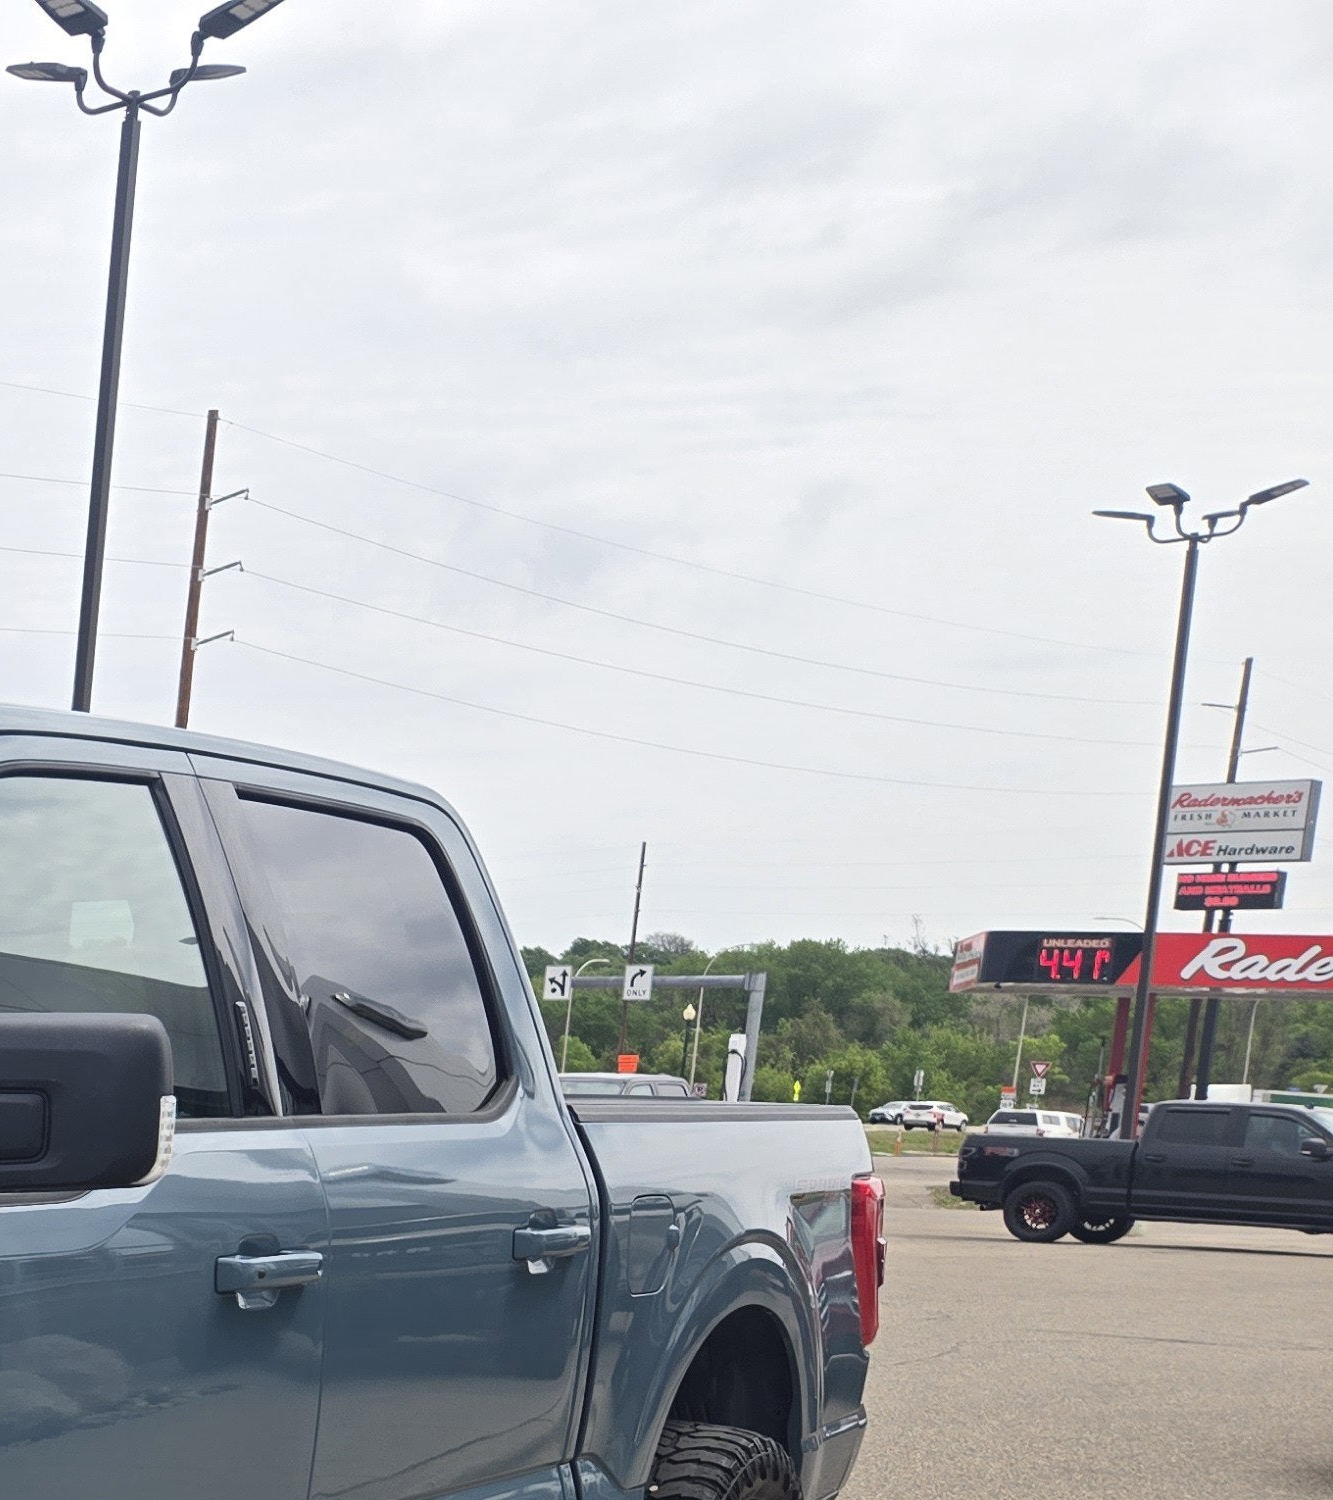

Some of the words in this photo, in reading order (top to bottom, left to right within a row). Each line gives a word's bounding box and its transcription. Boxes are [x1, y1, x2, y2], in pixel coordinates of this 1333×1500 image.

[1171, 790, 1304, 809] Radermacher's
[1173, 812, 1212, 822] FRESH
[1241, 809, 1298, 819] MARKET
[1166, 838, 1217, 858] ACE
[1216, 844, 1295, 857] Hardware
[1043, 938, 1111, 948] UNLEADED
[626, 989, 646, 997] ONLY
